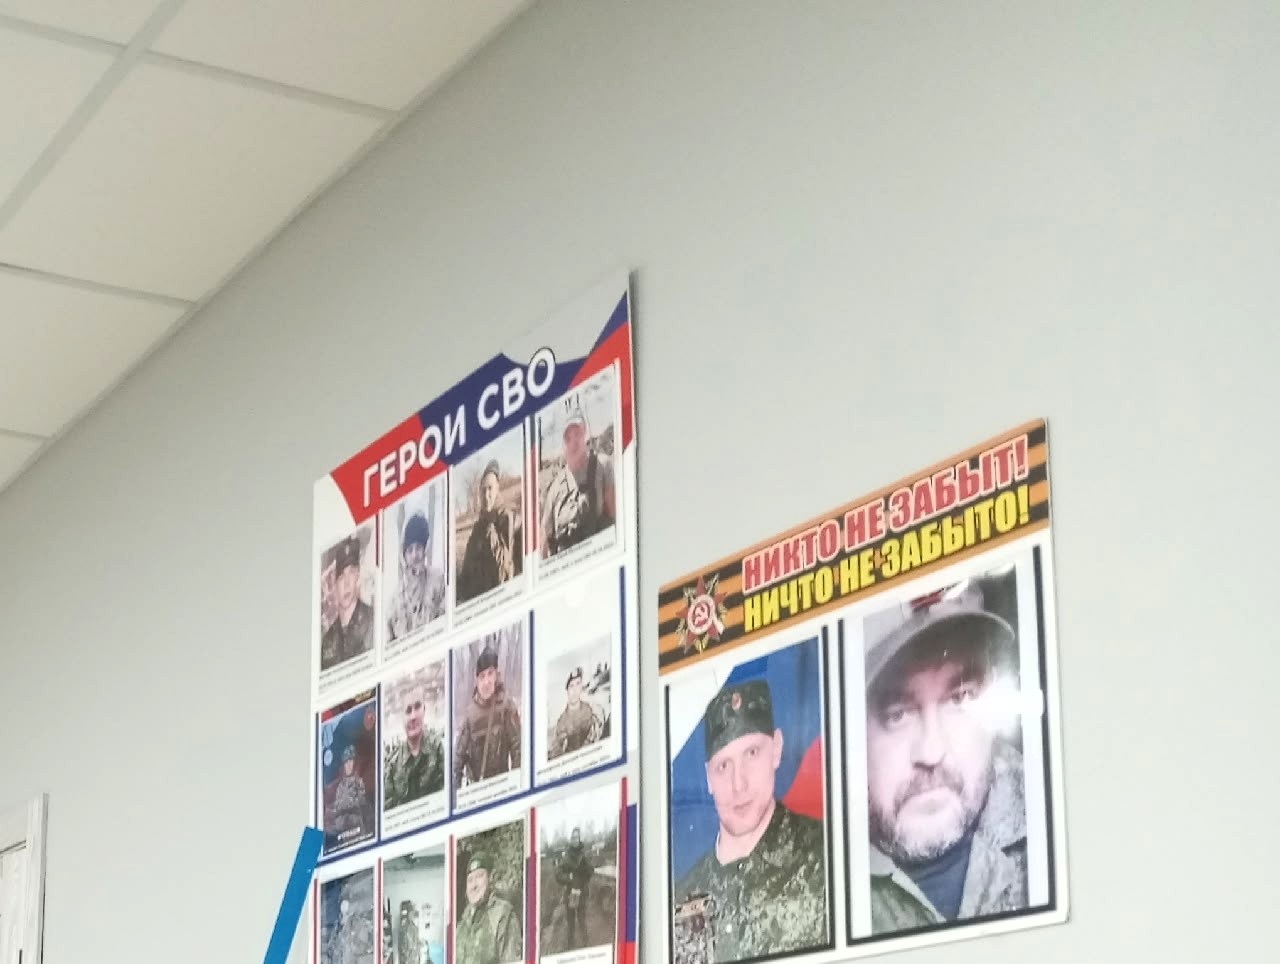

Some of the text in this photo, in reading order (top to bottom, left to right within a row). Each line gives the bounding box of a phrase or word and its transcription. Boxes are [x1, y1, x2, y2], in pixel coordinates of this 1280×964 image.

[363, 346, 556, 508] ГЕРОИ СВО
[742, 434, 1029, 594] НИКТО НЕ ЗАБЫТ!
[743, 484, 1029, 633] НИЧТО НЕ ЗАБЫТО!
